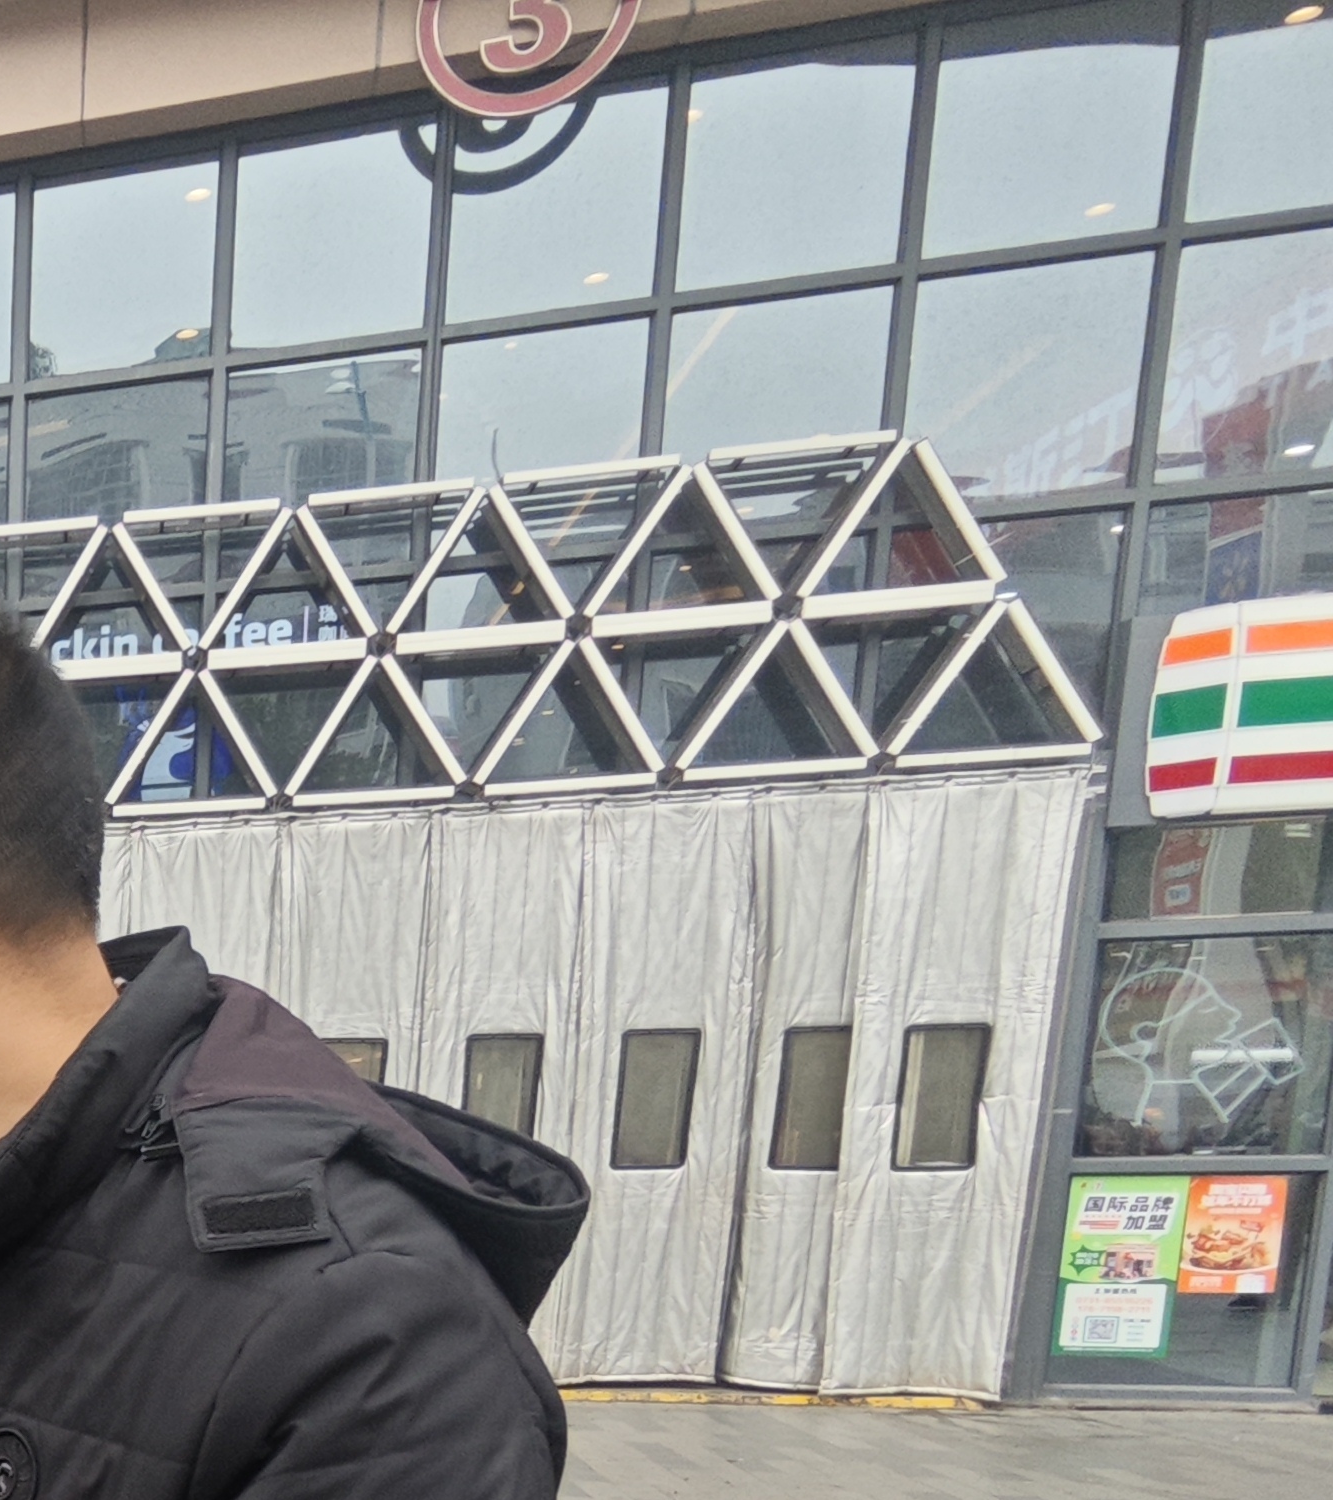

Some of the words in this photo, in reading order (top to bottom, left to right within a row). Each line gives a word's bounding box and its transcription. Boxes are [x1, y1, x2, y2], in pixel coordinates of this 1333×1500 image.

[480, 0, 573, 73] 3
[153, 613, 293, 656] fee
[1084, 1196, 1174, 1213] 国际品牌
[1123, 1215, 1168, 1231] 加盟
